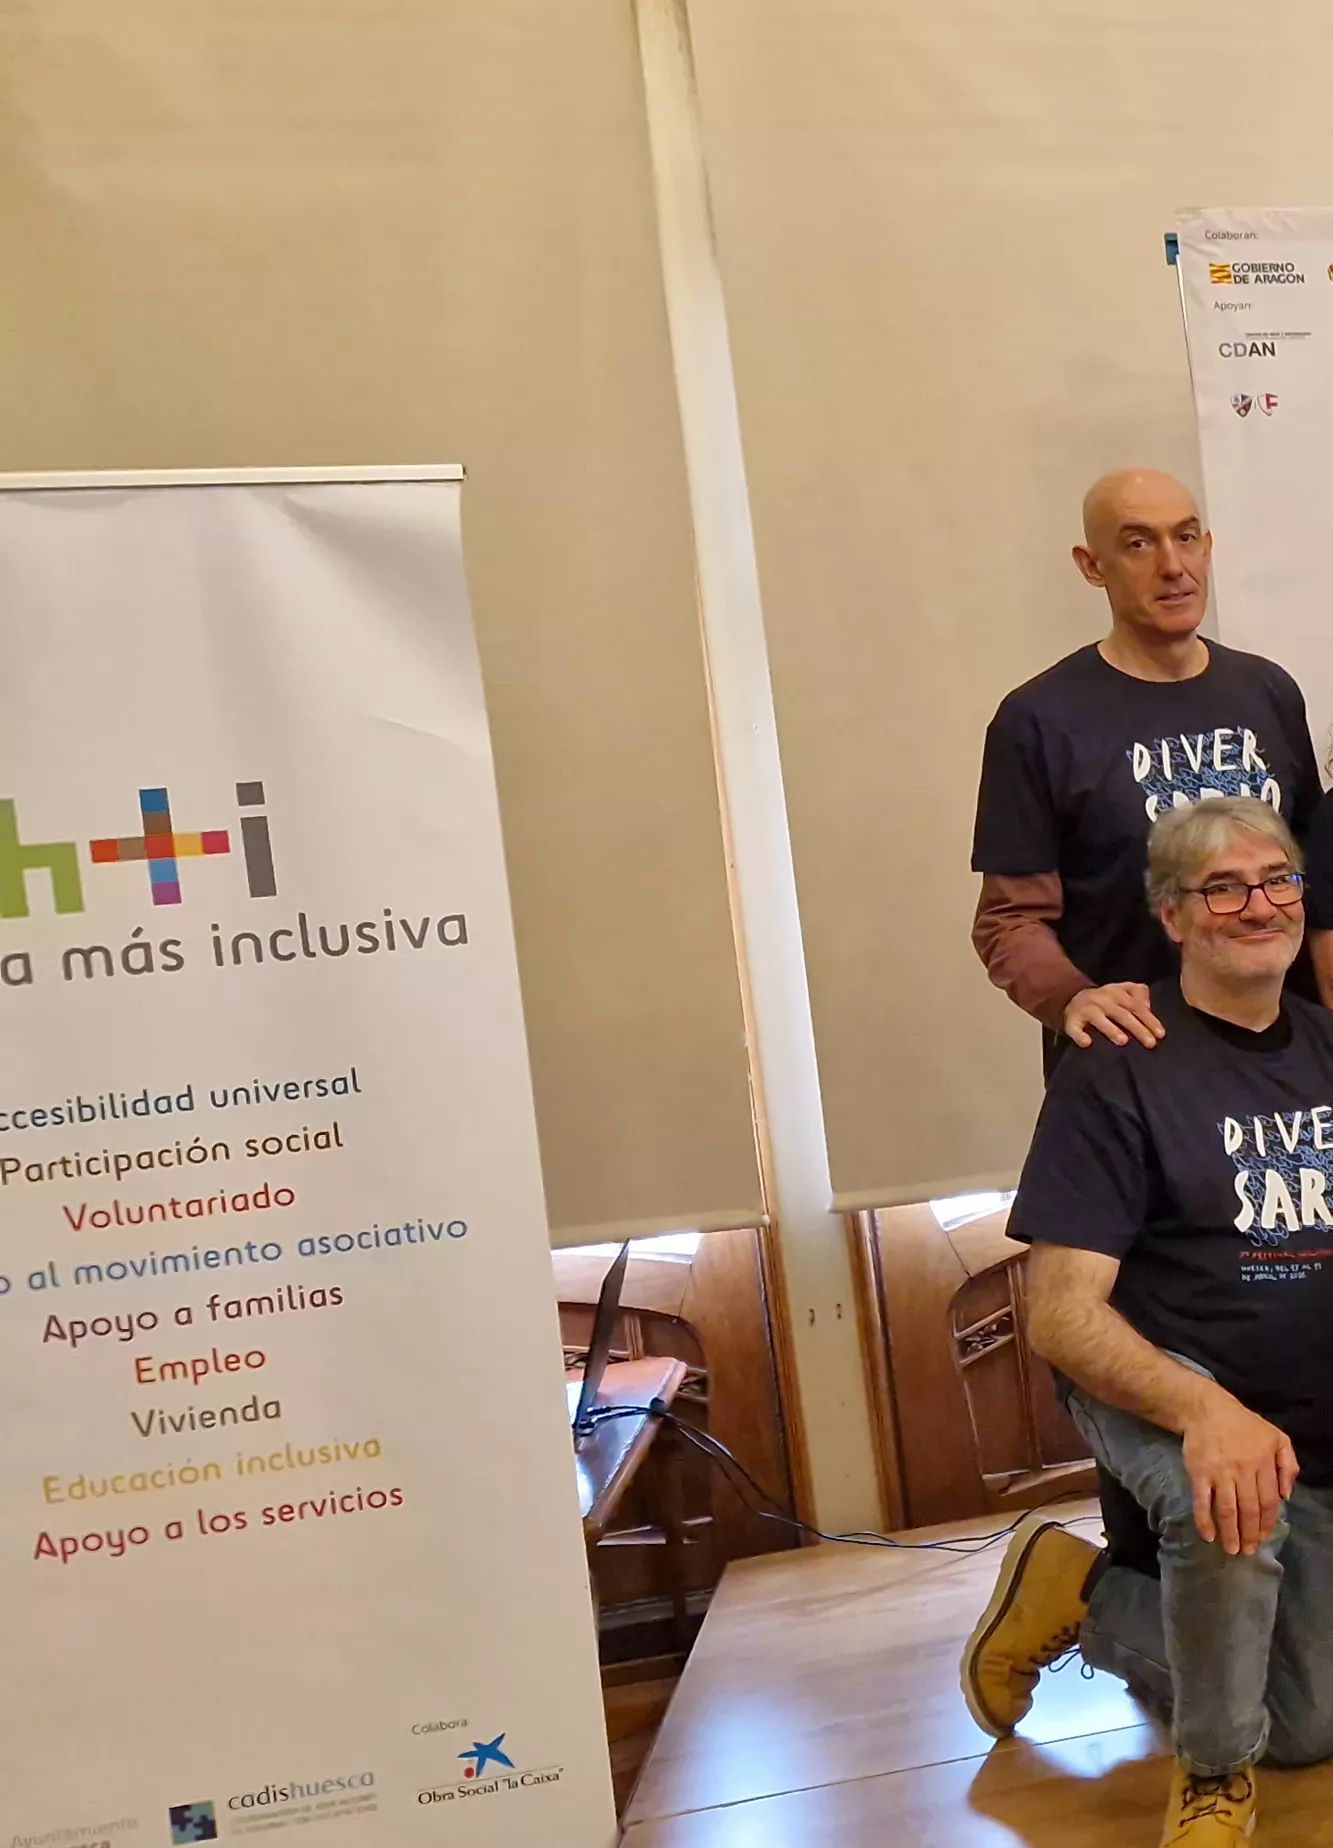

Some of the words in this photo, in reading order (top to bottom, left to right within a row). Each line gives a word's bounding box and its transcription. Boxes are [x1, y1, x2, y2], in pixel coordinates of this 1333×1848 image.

[1205, 230, 1259, 241] Colaboran:
[1232, 262, 1295, 273] GOBIERNO
[1233, 274, 1249, 284] DE
[1213, 300, 1252, 312] Apoyan:
[1218, 341, 1277, 358] CDAN
[1133, 728, 1267, 782] DIVER
[63, 927, 185, 982] más
[211, 908, 469, 968] inclusiva
[209, 1067, 362, 1109] universal
[0, 1136, 231, 1186] Participación
[245, 1122, 345, 1160] social
[63, 1183, 296, 1232] Voluntariado
[27, 1259, 59, 1293] al
[74, 1240, 283, 1286] movimiento
[298, 1218, 469, 1258] asociativo
[42, 1310, 159, 1348] Apoyo
[174, 1306, 194, 1326] a
[206, 1283, 345, 1322] familias
[134, 1347, 267, 1386] Empleo
[130, 1395, 282, 1438] Vivienda
[43, 1457, 222, 1504] Educación
[236, 1437, 382, 1477] inclusiva
[33, 1523, 149, 1564] Apoyo
[164, 1520, 183, 1541] a
[197, 1508, 248, 1536] los
[261, 1485, 404, 1527] servicios
[411, 1717, 468, 1736] Colabora
[417, 1790, 455, 1805] Obra
[458, 1780, 499, 1798] Social
